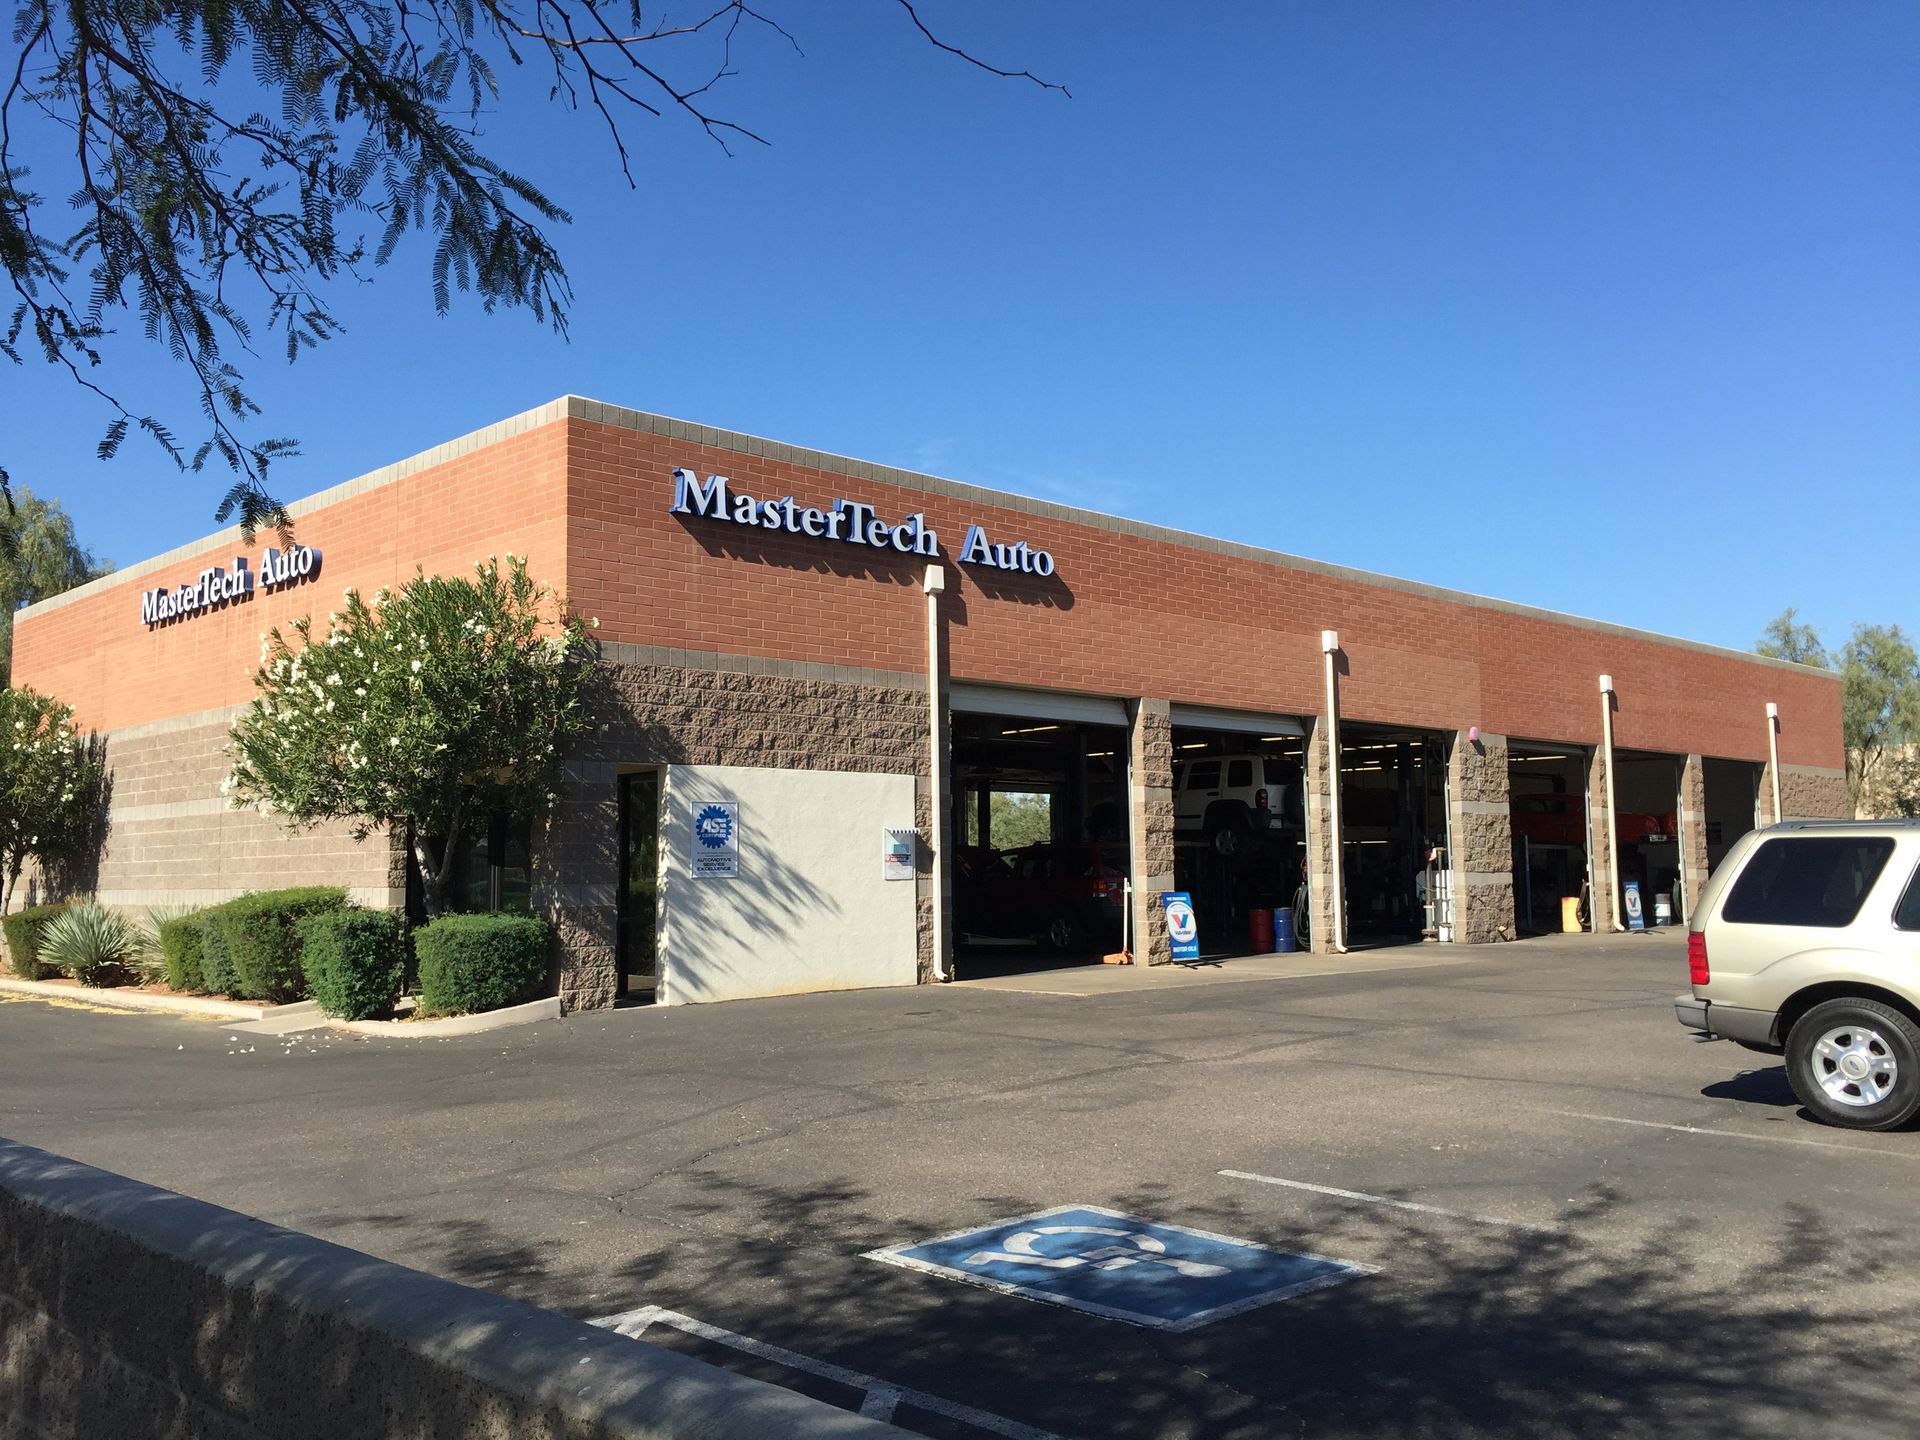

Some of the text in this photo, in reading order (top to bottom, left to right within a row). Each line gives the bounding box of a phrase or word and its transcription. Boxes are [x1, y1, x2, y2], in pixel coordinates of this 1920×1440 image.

[670, 467, 1056, 578] MasterTech Auto
[140, 545, 318, 625] MasterTech Auto
[700, 818, 727, 833] ASE
